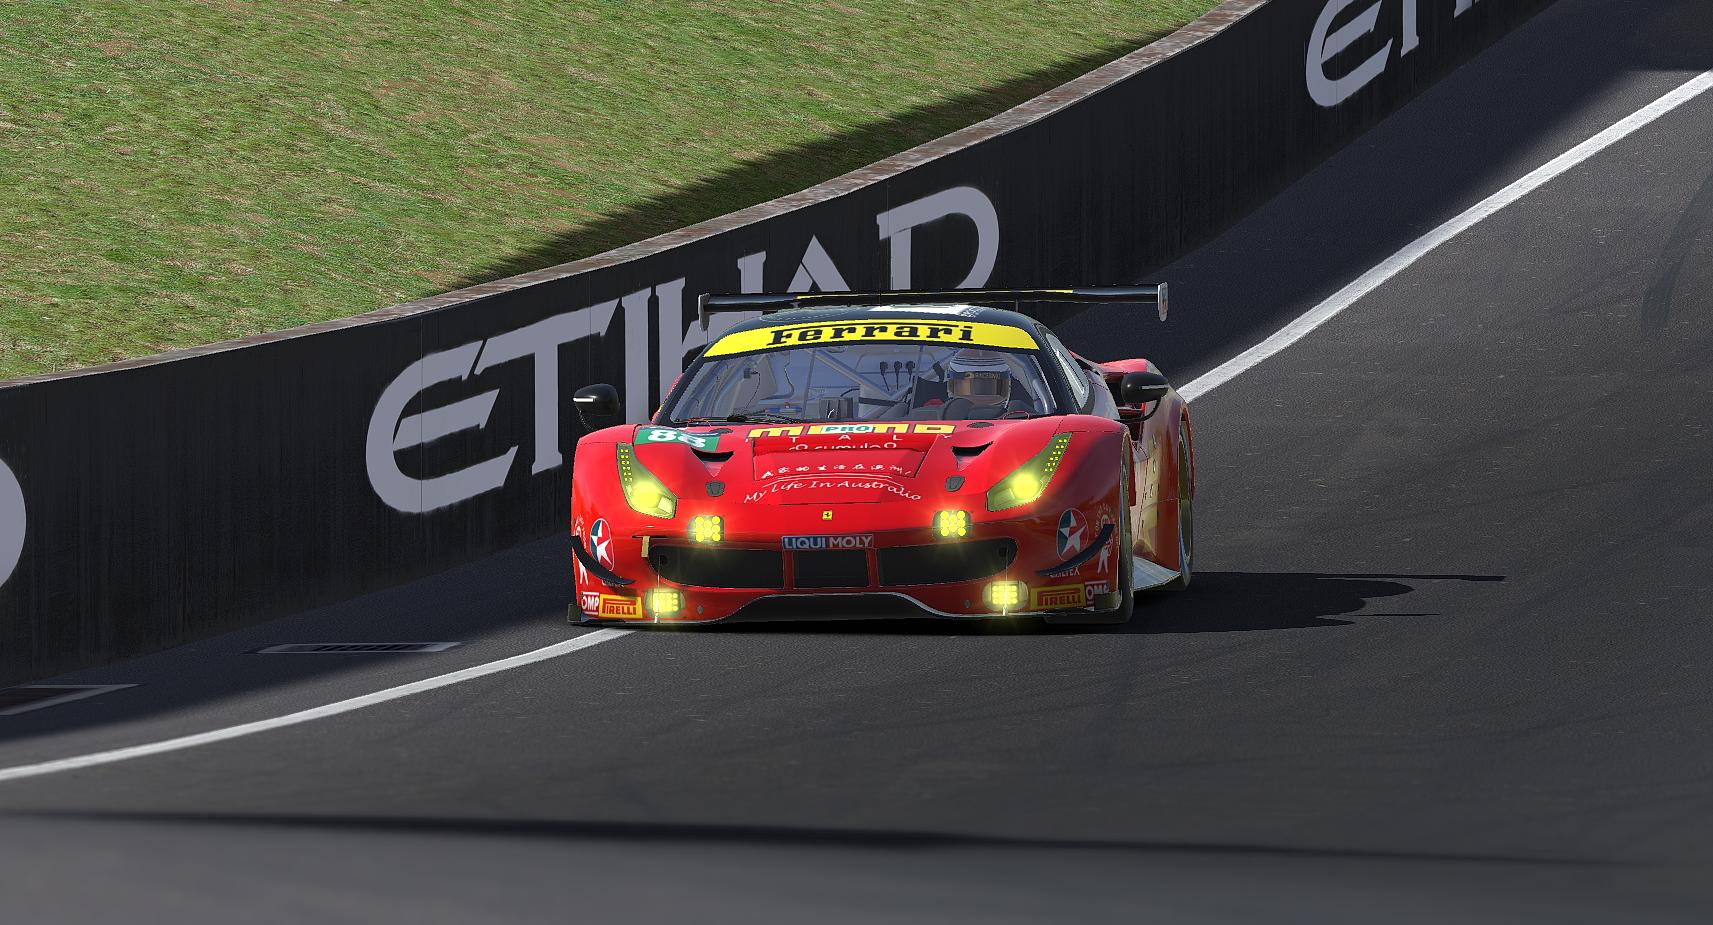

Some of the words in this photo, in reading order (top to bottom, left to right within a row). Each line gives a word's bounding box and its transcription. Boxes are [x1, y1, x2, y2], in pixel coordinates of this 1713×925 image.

[766, 321, 974, 346] Ferrari
[744, 489, 767, 503] My
[771, 481, 807, 493] Life
[808, 480, 835, 489] In
[837, 480, 921, 500] Australia
[783, 536, 826, 549] LIQUI
[829, 535, 873, 549] MOLY
[581, 596, 599, 611] OMP
[602, 598, 637, 615] PIRELLI
